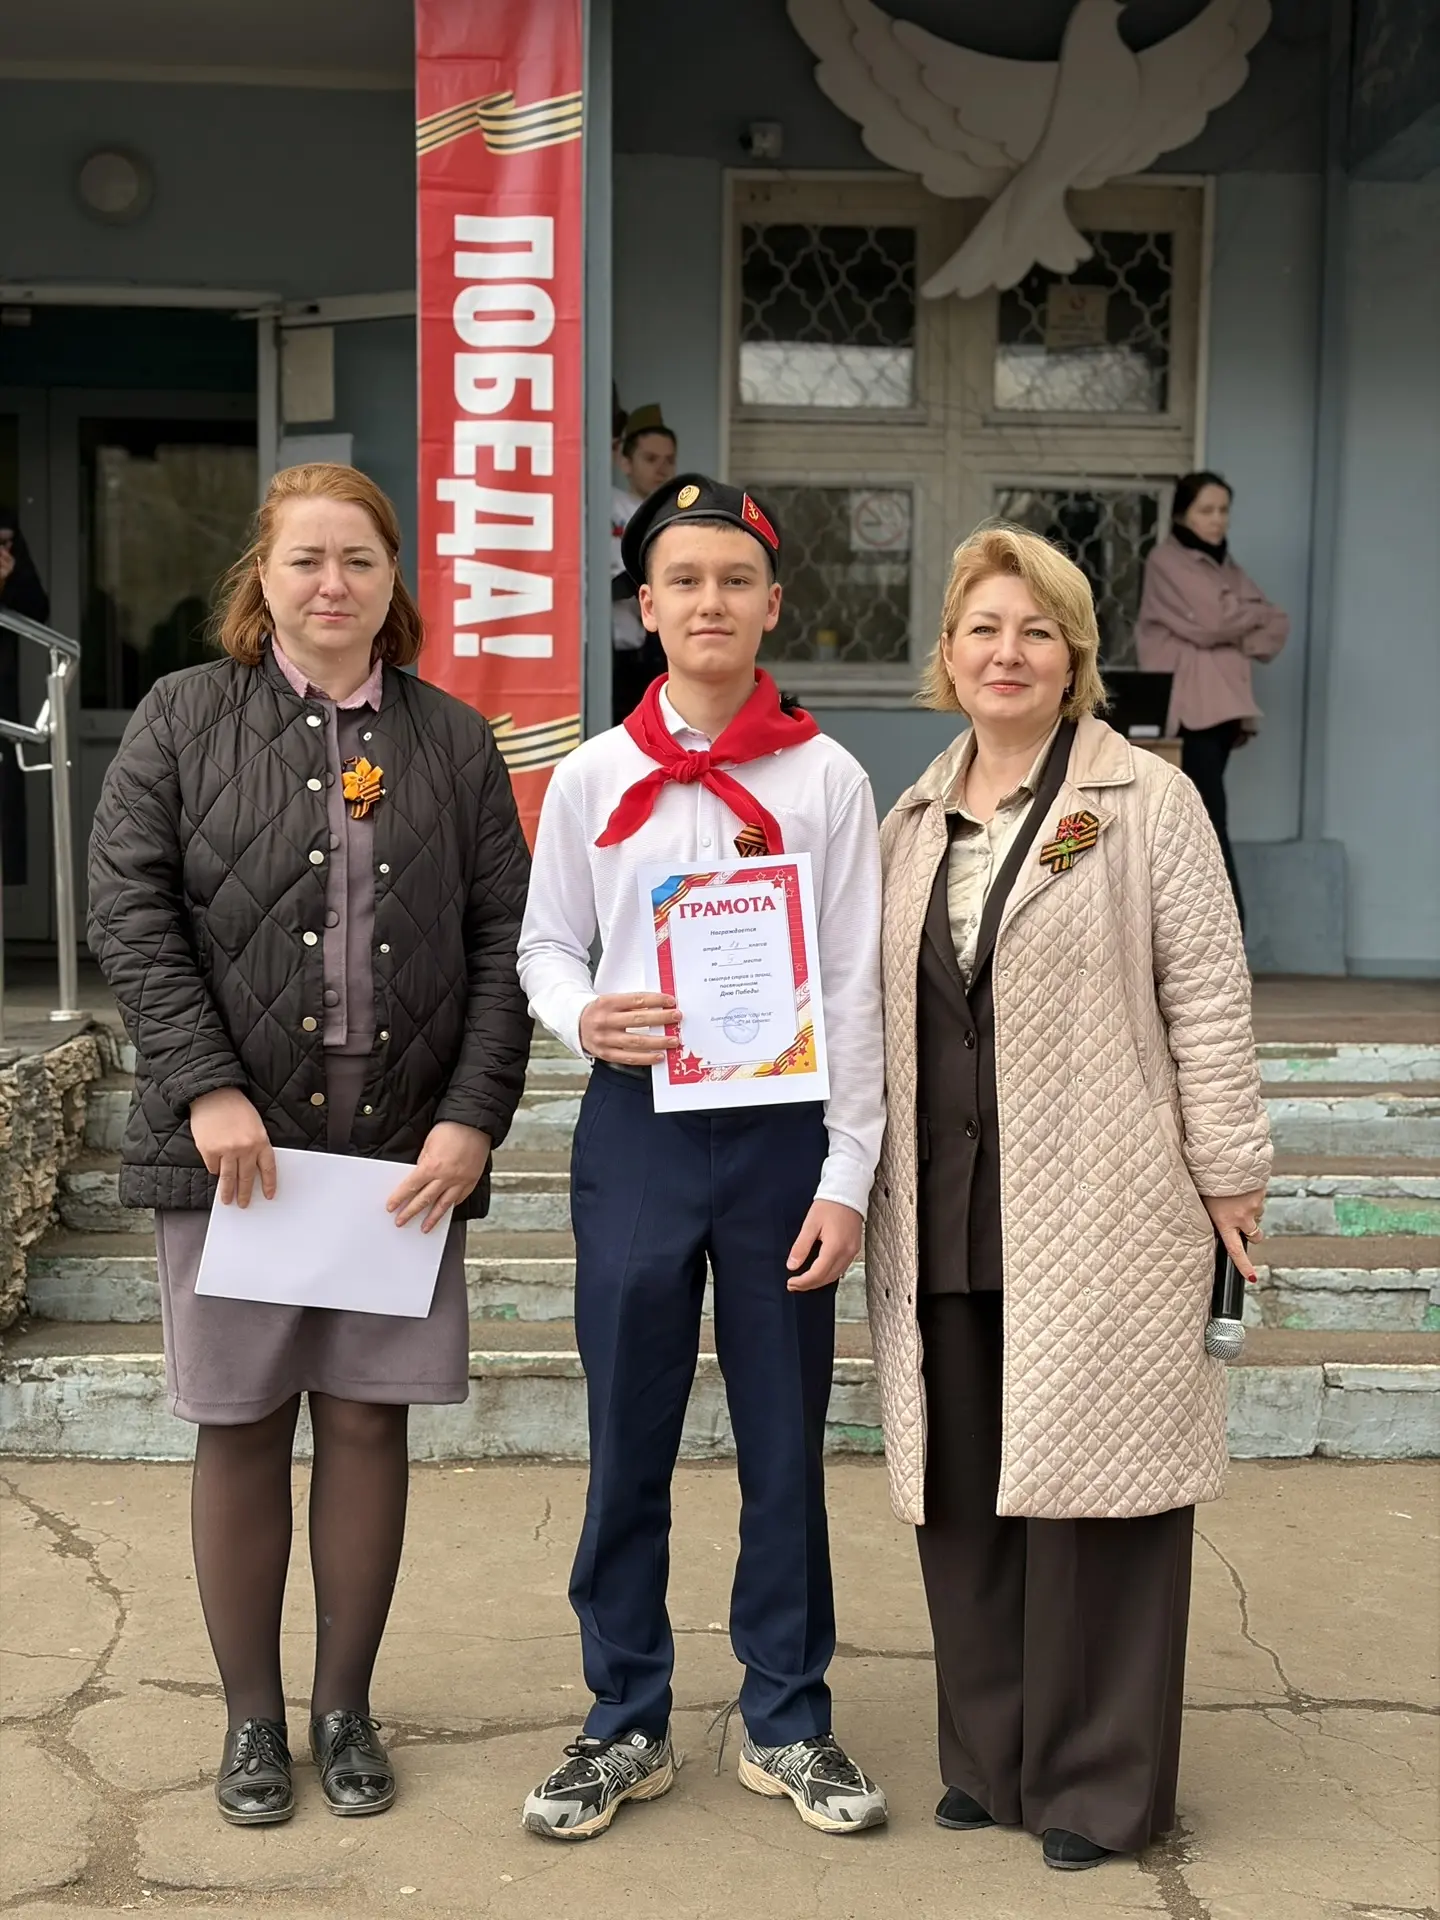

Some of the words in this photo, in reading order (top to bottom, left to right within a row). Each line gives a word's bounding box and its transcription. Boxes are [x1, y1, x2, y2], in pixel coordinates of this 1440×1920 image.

[436, 214, 555, 658] ПОБЕДА!
[679, 895, 776, 919] ГРАМОТА
[710, 927, 757, 936] Награждается
[719, 990, 734, 998] Дню
[735, 988, 760, 996] Победы
